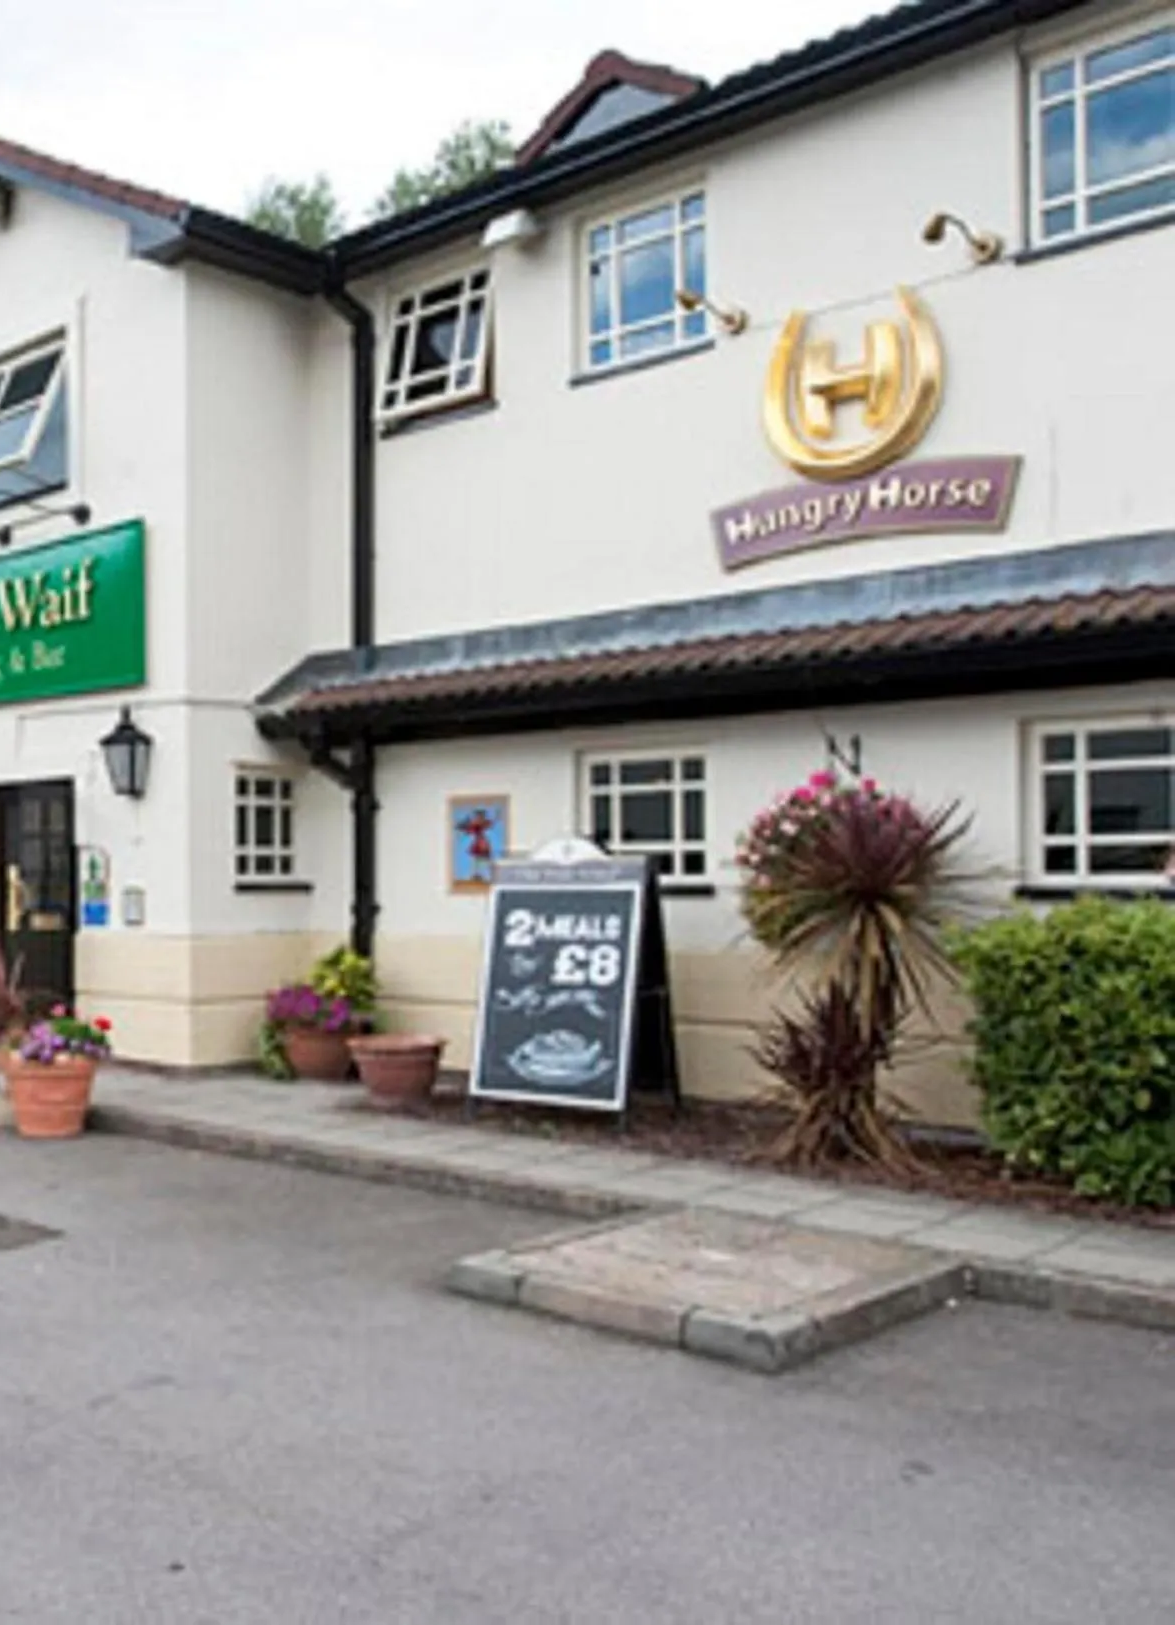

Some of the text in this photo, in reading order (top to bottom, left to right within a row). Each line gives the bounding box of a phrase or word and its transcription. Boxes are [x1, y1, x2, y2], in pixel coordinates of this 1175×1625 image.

[504, 908, 622, 947] 2 MEALS
[550, 944, 621, 986] £8
